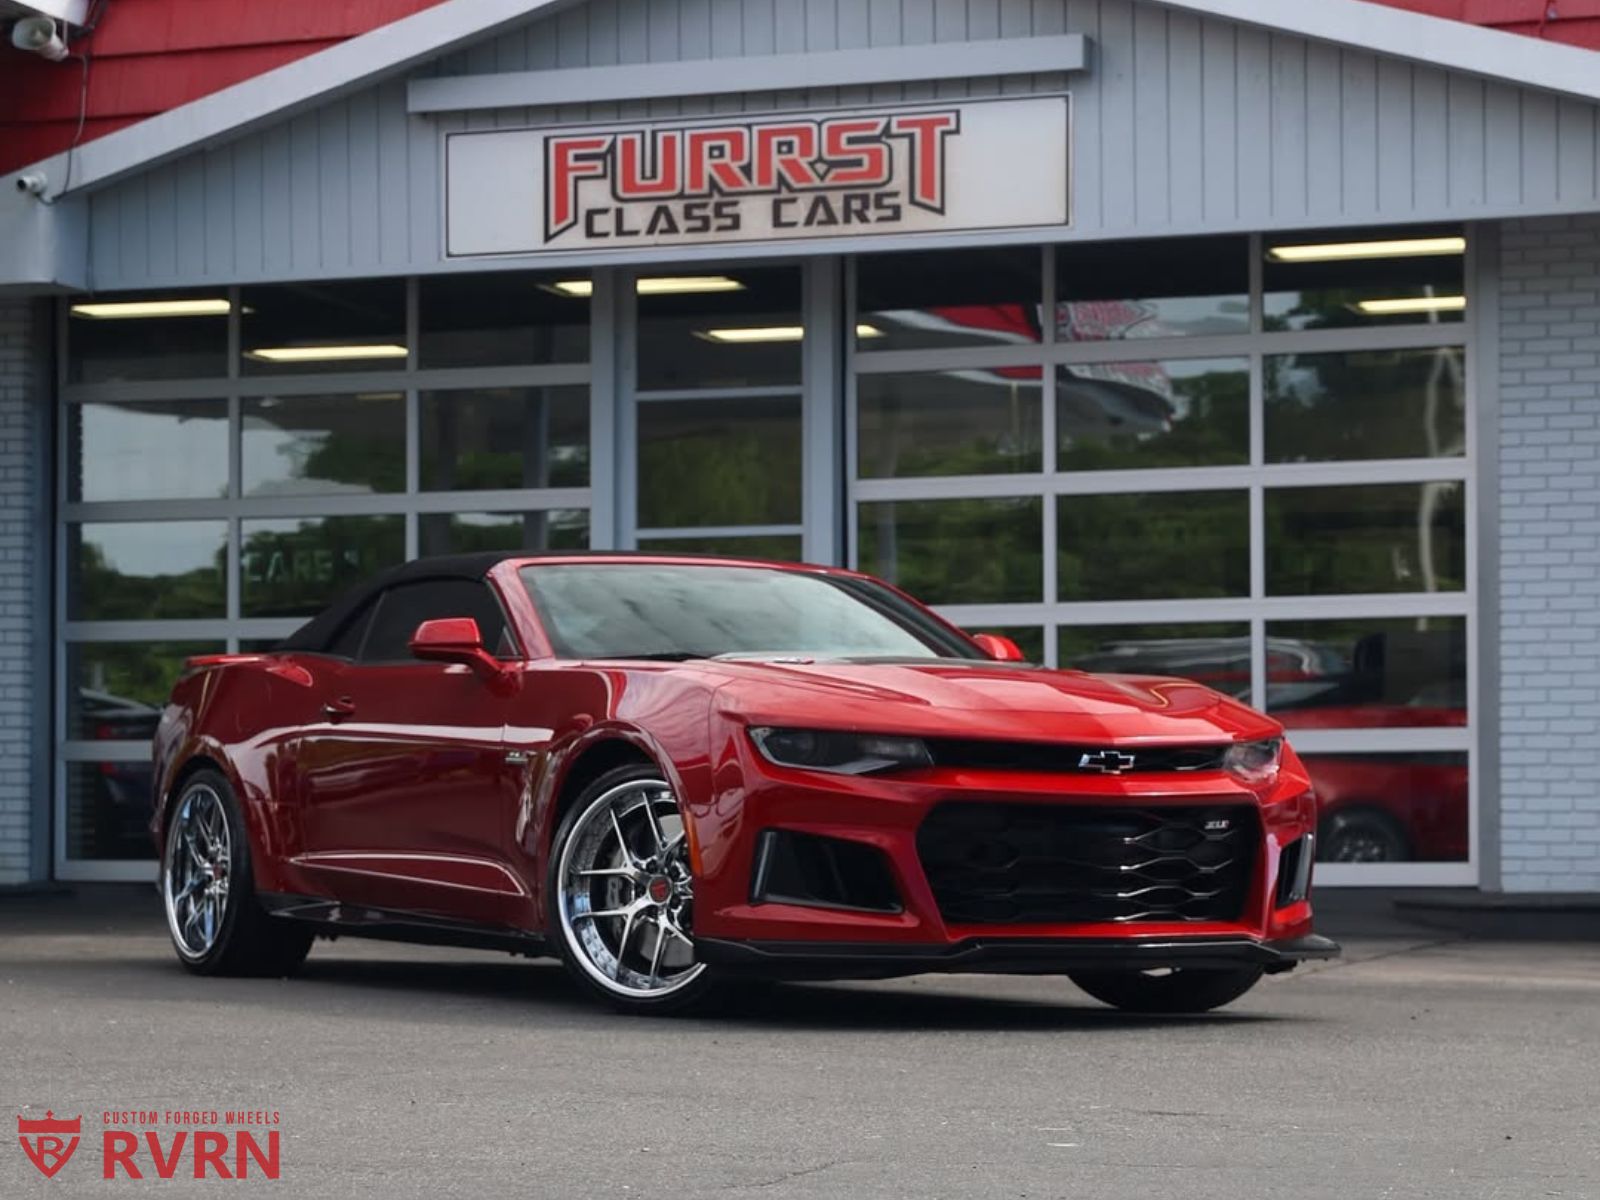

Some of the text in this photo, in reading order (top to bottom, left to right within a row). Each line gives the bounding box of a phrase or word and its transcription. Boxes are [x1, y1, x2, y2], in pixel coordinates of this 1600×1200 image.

[543, 108, 961, 244] FURRST
[585, 191, 902, 239] CLASS CARS
